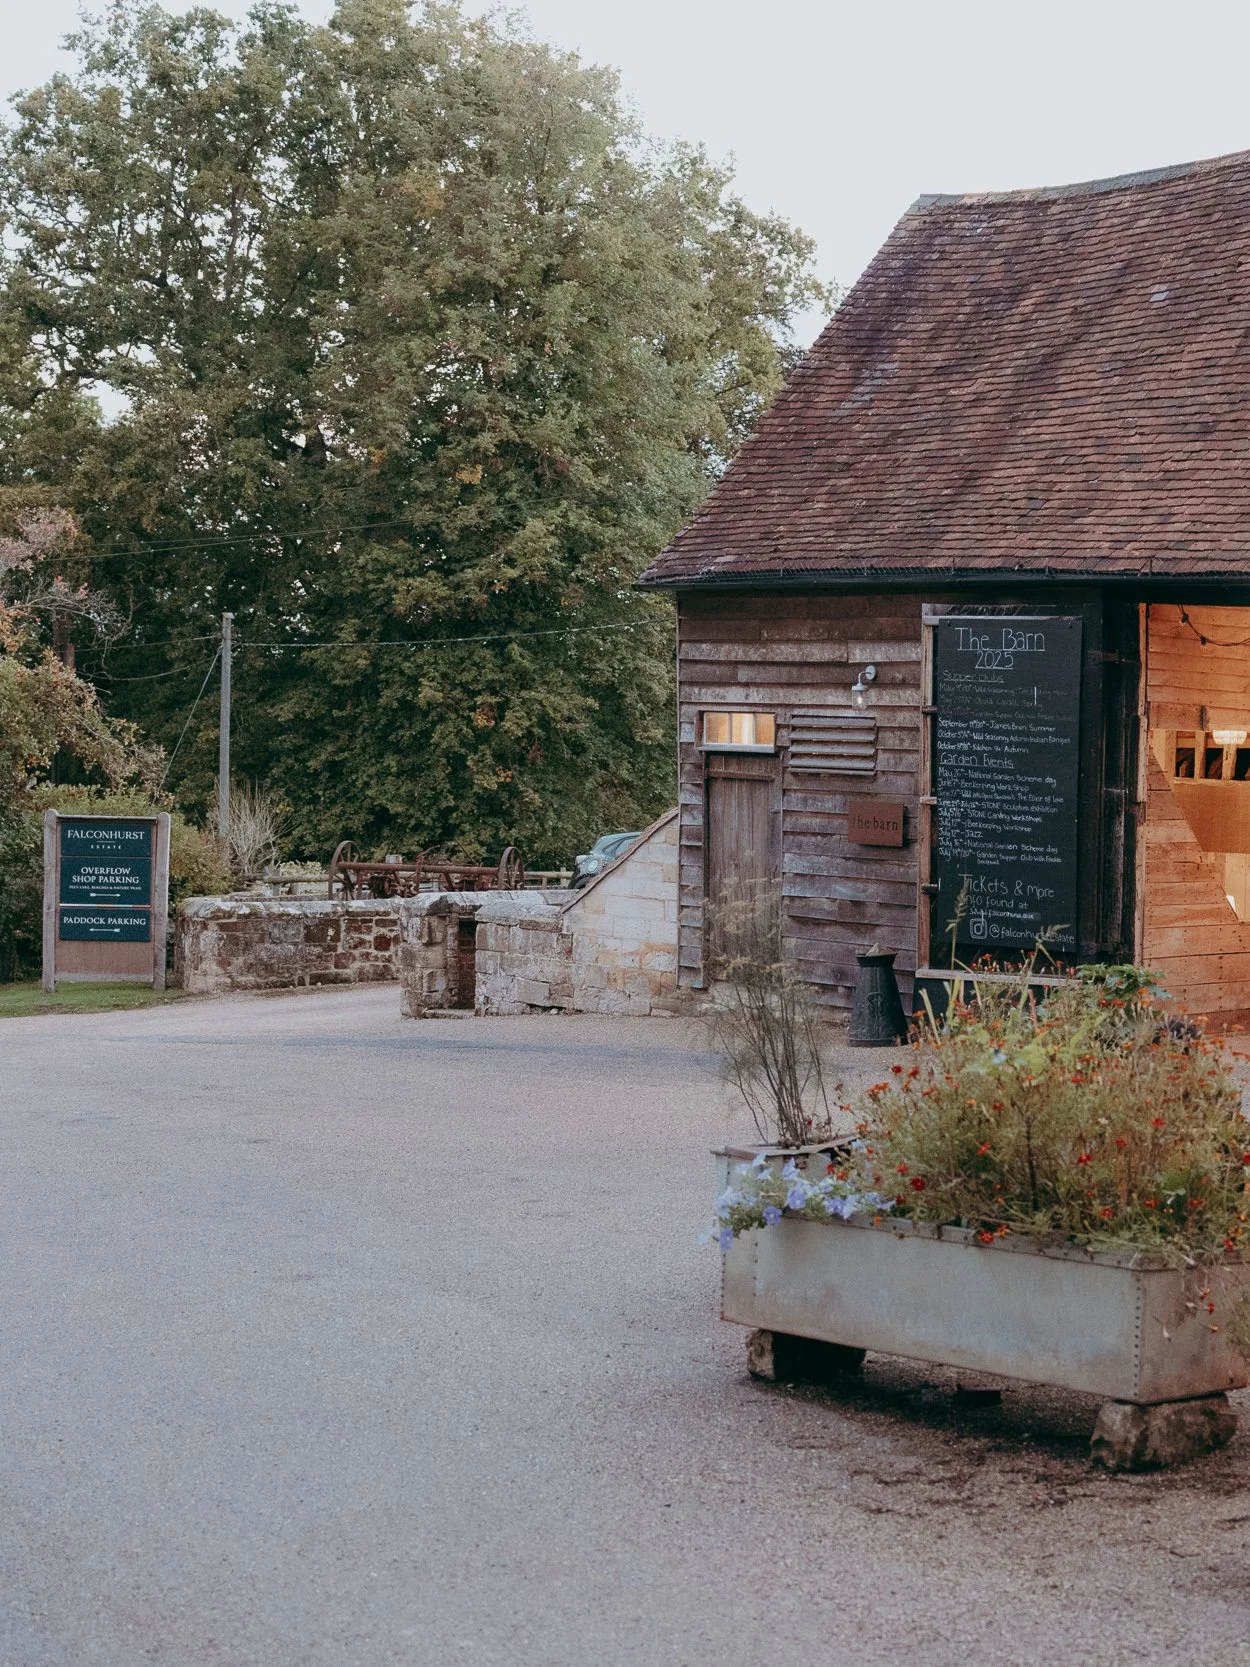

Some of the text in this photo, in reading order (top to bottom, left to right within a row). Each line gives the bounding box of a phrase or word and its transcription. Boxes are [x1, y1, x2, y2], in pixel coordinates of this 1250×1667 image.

[955, 627, 1045, 651] The Barn
[975, 651, 1014, 669] 2025
[940, 752, 1014, 768] Garden Events
[939, 766, 953, 779] May
[1045, 776, 1057, 788] day
[67, 829, 145, 840] FALCONHURST
[939, 847, 952, 862] July
[1046, 844, 1058, 855] day
[80, 866, 131, 875] OVERFLOW
[72, 875, 140, 884] SHOP PARKING
[1013, 879, 1024, 897] &
[986, 896, 1014, 909] found
[1018, 901, 1029, 910] at
[63, 916, 146, 926] PADDOCK PARKING
